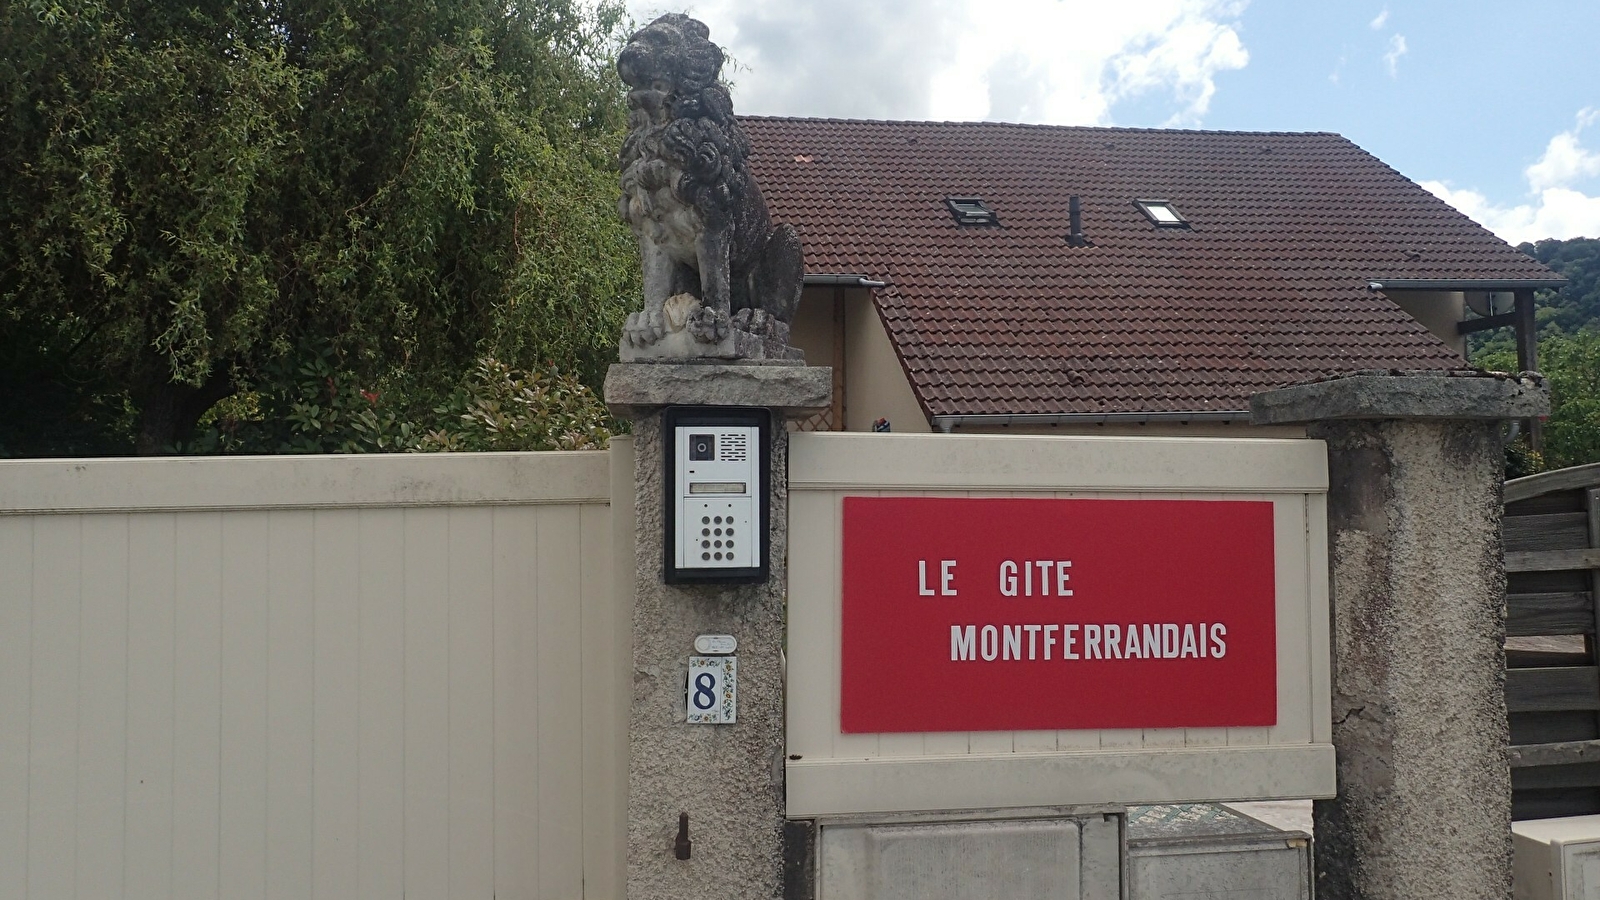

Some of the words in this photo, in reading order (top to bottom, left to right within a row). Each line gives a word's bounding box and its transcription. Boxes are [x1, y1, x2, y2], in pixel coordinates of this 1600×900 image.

[918, 560, 957, 596] LE
[999, 560, 1074, 596] GITE
[950, 622, 1227, 661] MONTFERRANDAIS
[693, 672, 716, 710] 8
